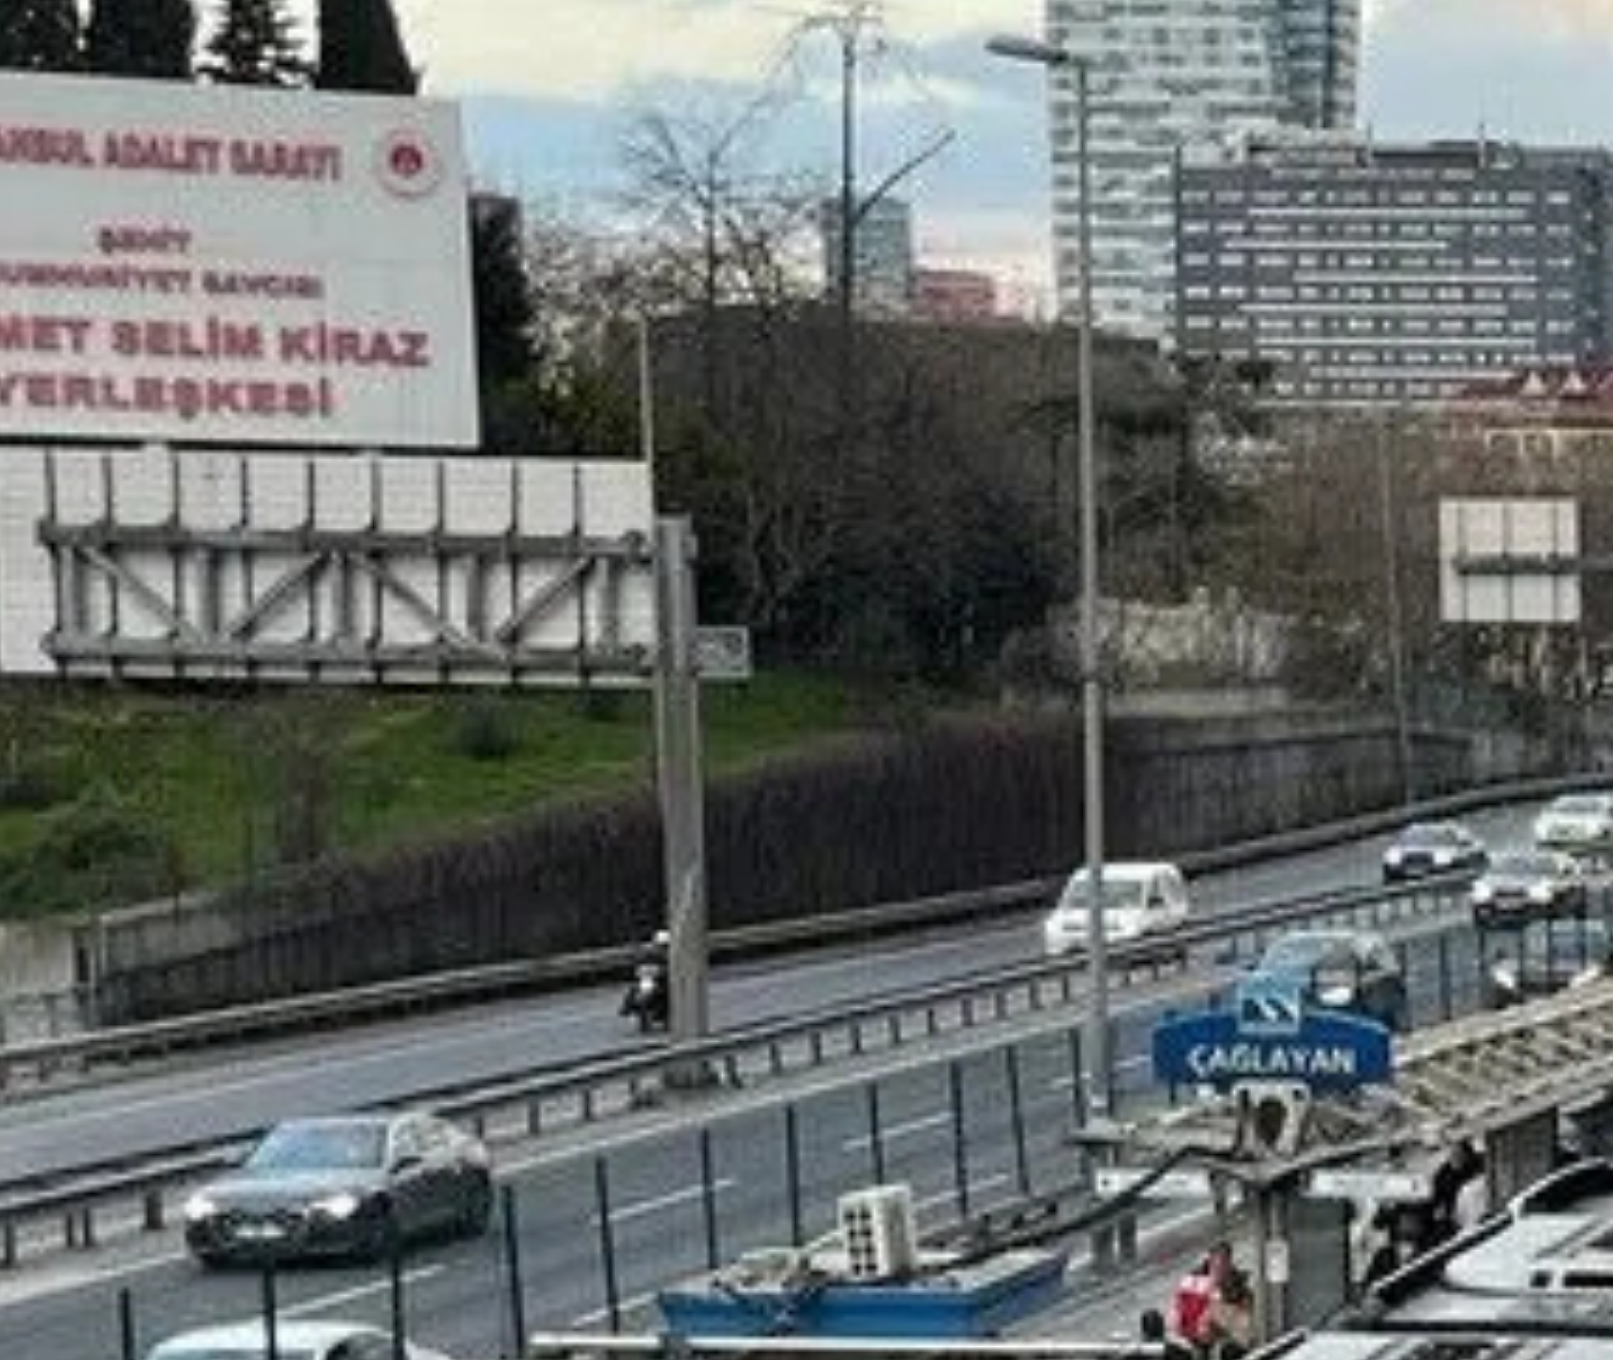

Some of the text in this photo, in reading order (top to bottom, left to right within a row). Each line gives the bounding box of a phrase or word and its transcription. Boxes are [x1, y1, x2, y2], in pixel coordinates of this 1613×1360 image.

[111, 315, 263, 361] SELİM
[280, 320, 431, 370] KİRAZ
[1186, 1041, 1357, 1078] ÇAĞLAYAN
